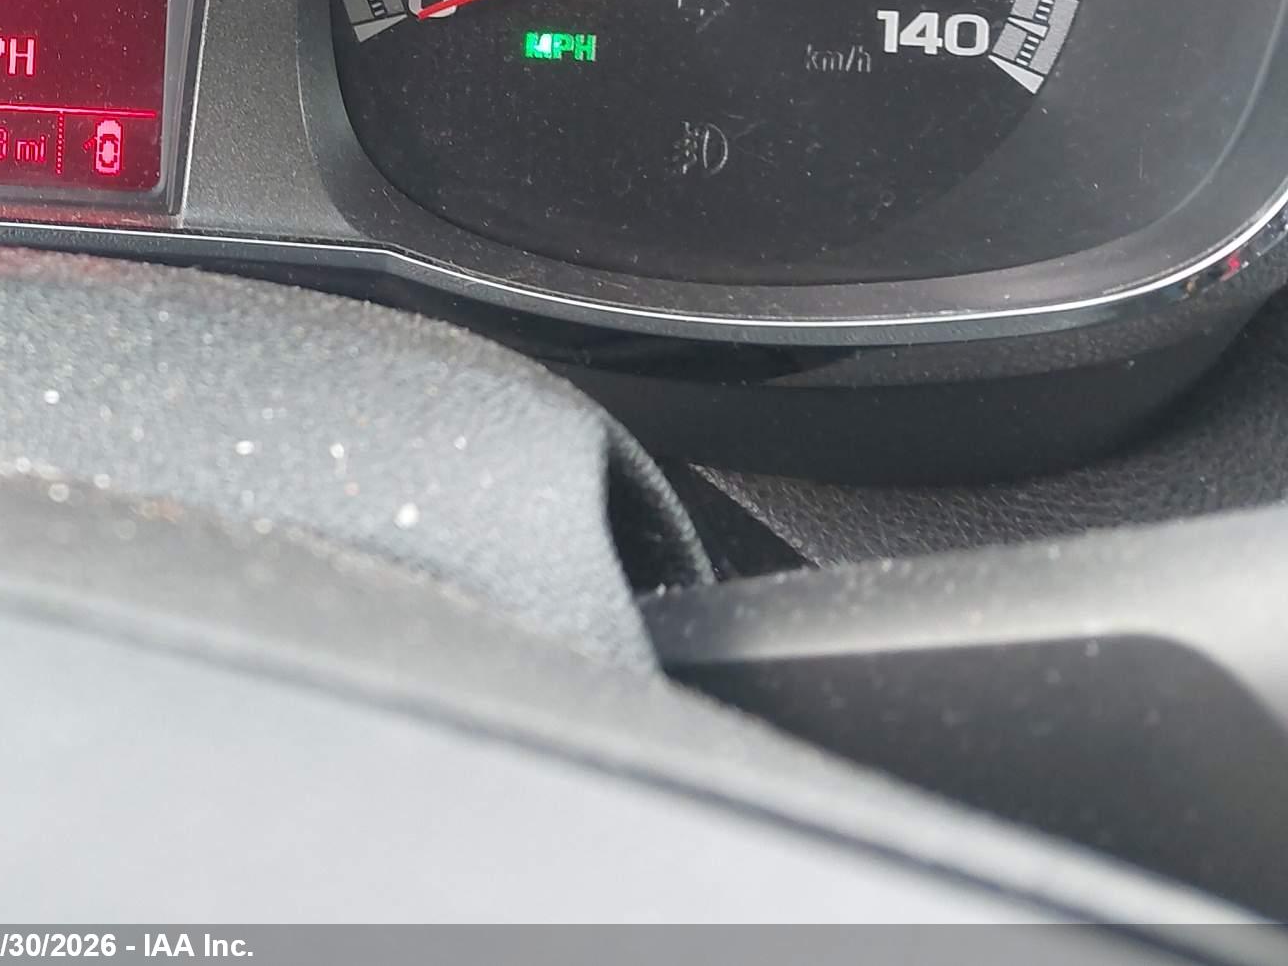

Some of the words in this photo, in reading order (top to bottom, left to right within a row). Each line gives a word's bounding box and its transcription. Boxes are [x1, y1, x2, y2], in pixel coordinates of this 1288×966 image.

[524, 32, 597, 62] MPH
[876, 10, 990, 57] 140
[805, 43, 872, 74] km/h
[15, 135, 46, 162] mi
